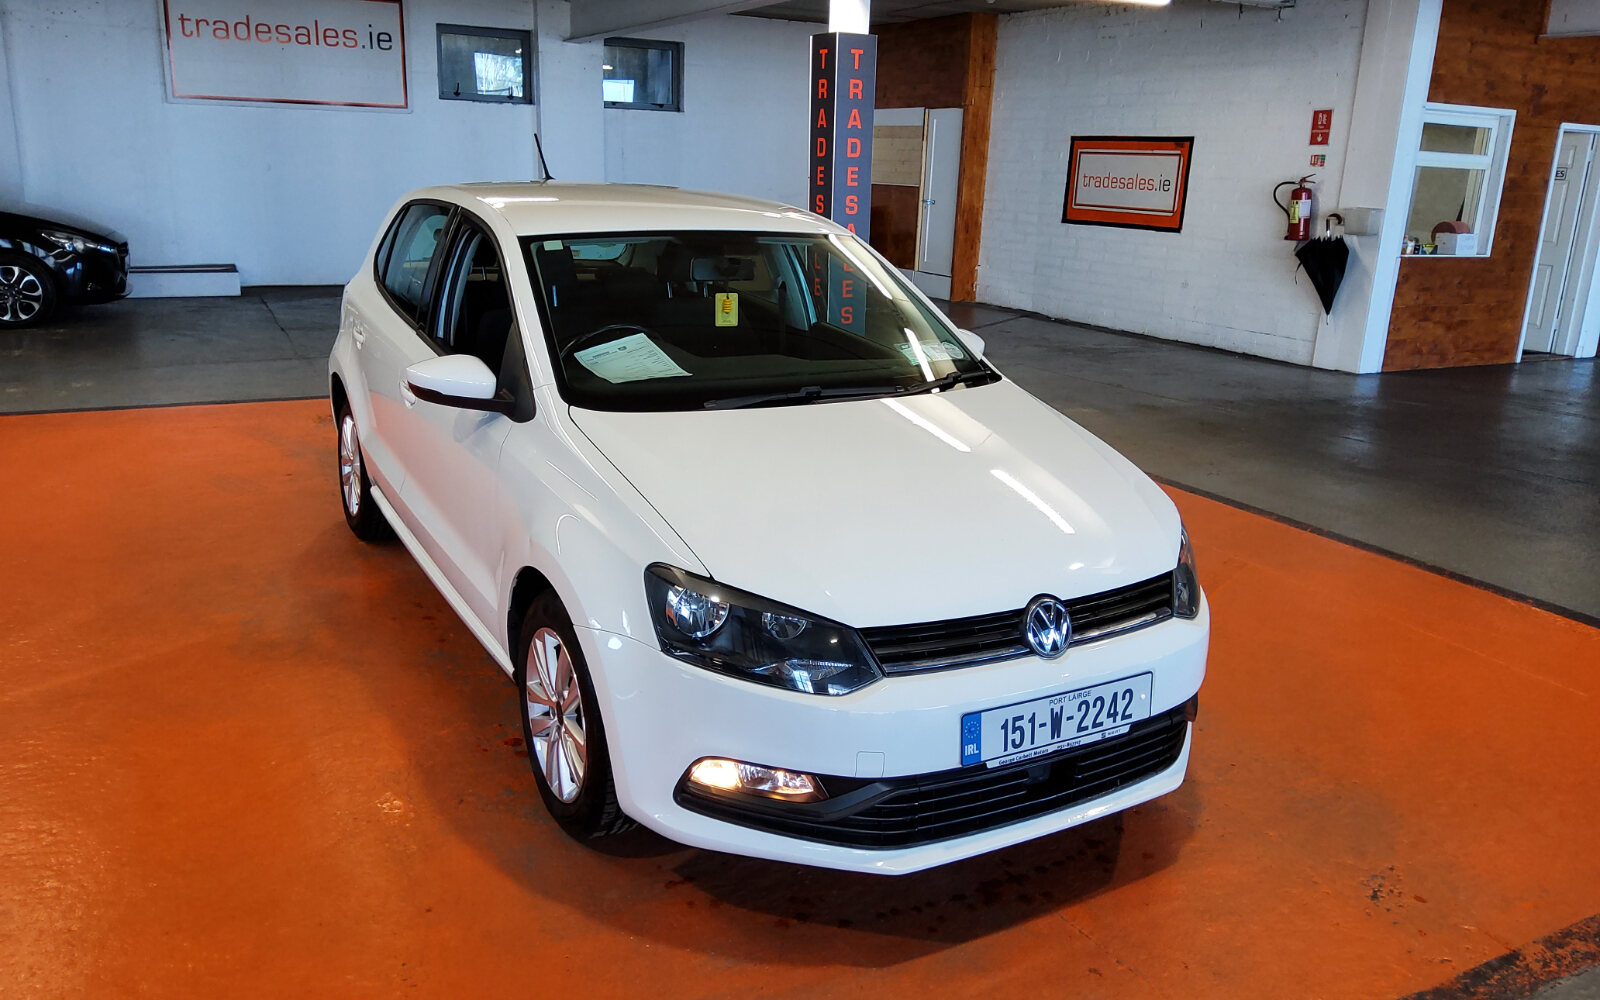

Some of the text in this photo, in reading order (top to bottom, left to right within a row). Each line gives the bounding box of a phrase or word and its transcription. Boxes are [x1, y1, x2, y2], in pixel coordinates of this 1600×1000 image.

[178, 13, 393, 51] tradesales.ie
[1082, 171, 1171, 192] tradesales.ie
[1049, 695, 1067, 706] PORT
[1000, 688, 1134, 753] 151-W-2242
[964, 743, 979, 757] IRL
